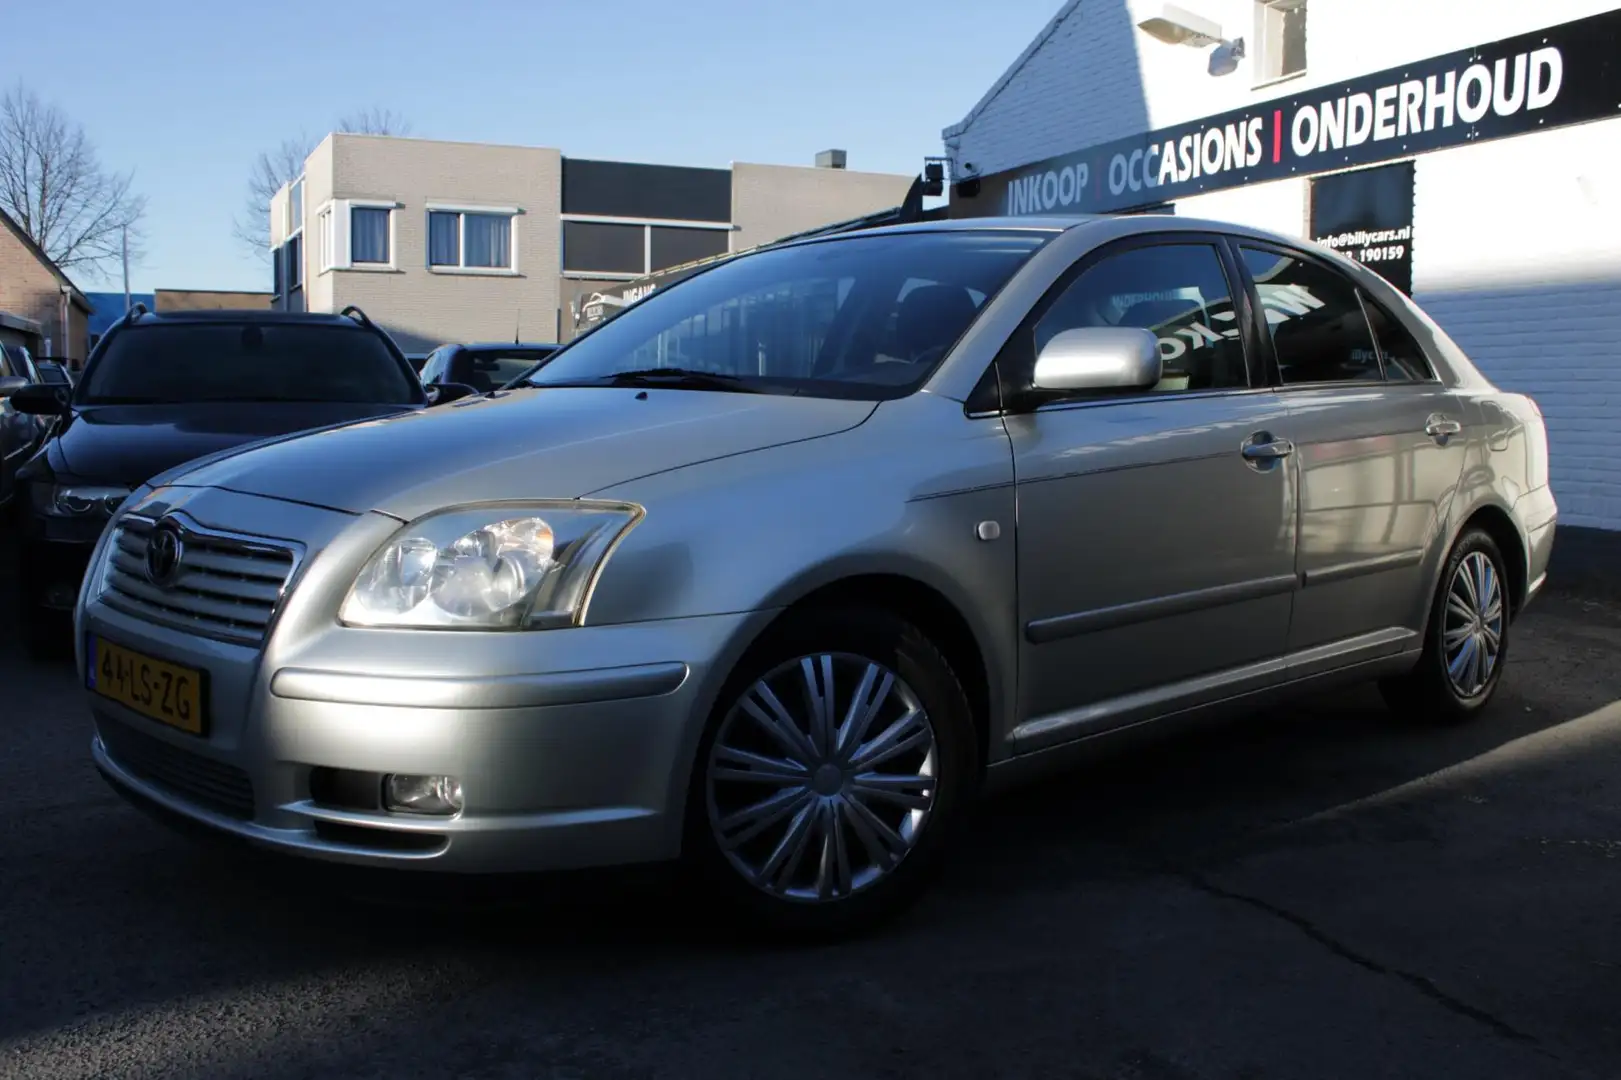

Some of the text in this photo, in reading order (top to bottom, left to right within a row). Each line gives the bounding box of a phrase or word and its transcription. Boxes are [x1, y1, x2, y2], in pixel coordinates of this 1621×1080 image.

[1007, 46, 1563, 216] INKOOP OCCASIONS ONDERHOUD
[1359, 245, 1405, 262] 190159
